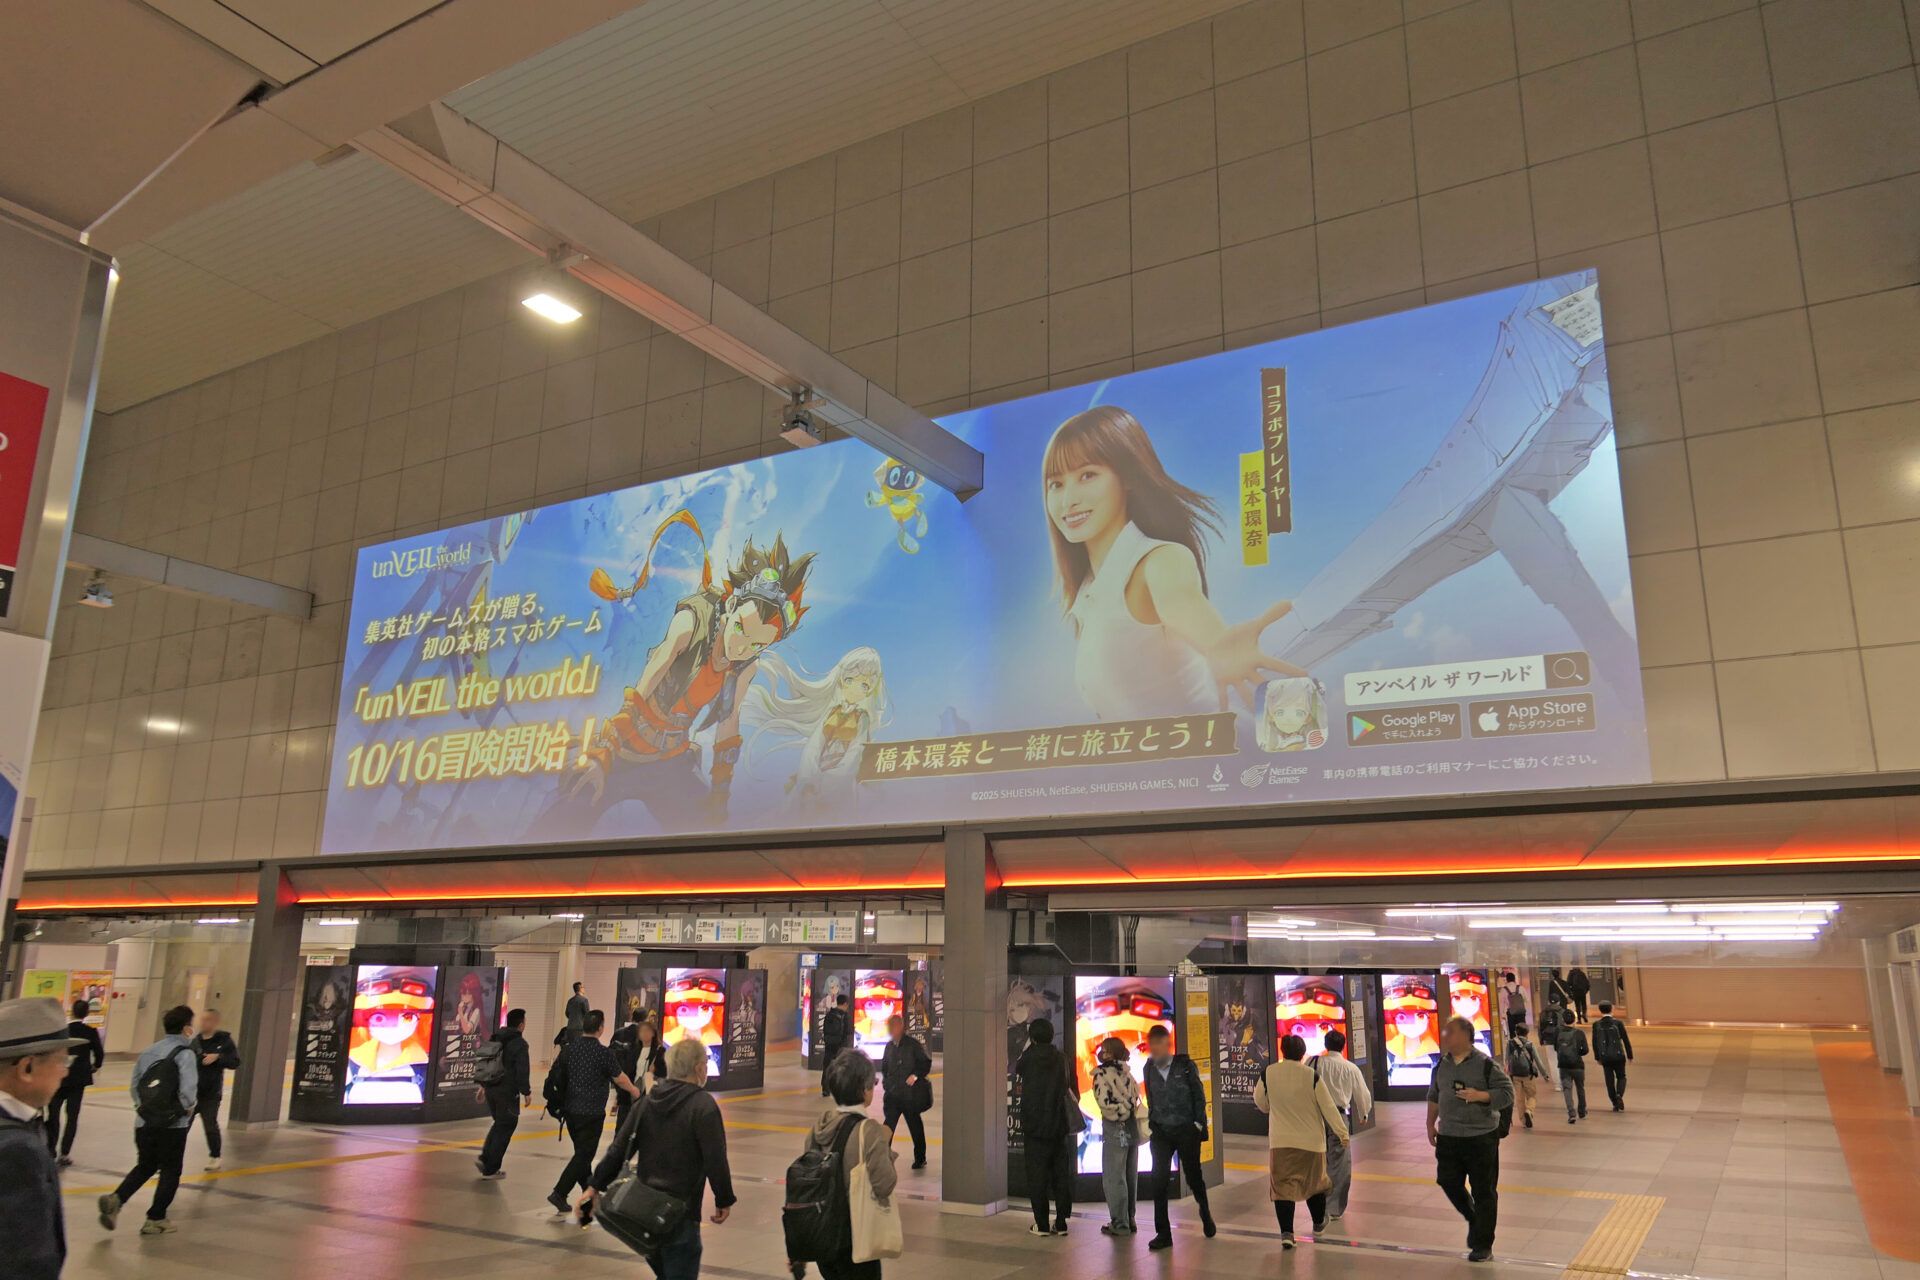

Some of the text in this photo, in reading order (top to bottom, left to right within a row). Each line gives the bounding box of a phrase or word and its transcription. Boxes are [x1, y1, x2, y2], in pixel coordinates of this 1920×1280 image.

[1267, 384, 1286, 517] コラボプレイヤー
[1243, 470, 1263, 548] 橋本環奈
[372, 546, 437, 578] unVEIL
[436, 541, 472, 566] world
[363, 592, 545, 645] 集英社ゲームズが贈る、
[421, 610, 602, 662] 初の本格スマホゲーム
[354, 653, 600, 721] 「unVEIL the world」
[1443, 671, 1461, 689] ザ
[1467, 665, 1532, 687] ワールド
[1381, 710, 1456, 729] Google Play
[1507, 699, 1587, 720] App Store
[1507, 716, 1585, 732] からダウンロード
[1268, 775, 1300, 785] Games
[1269, 766, 1309, 776] NetEase
[1090, 782, 1138, 793] SHUEISHA
